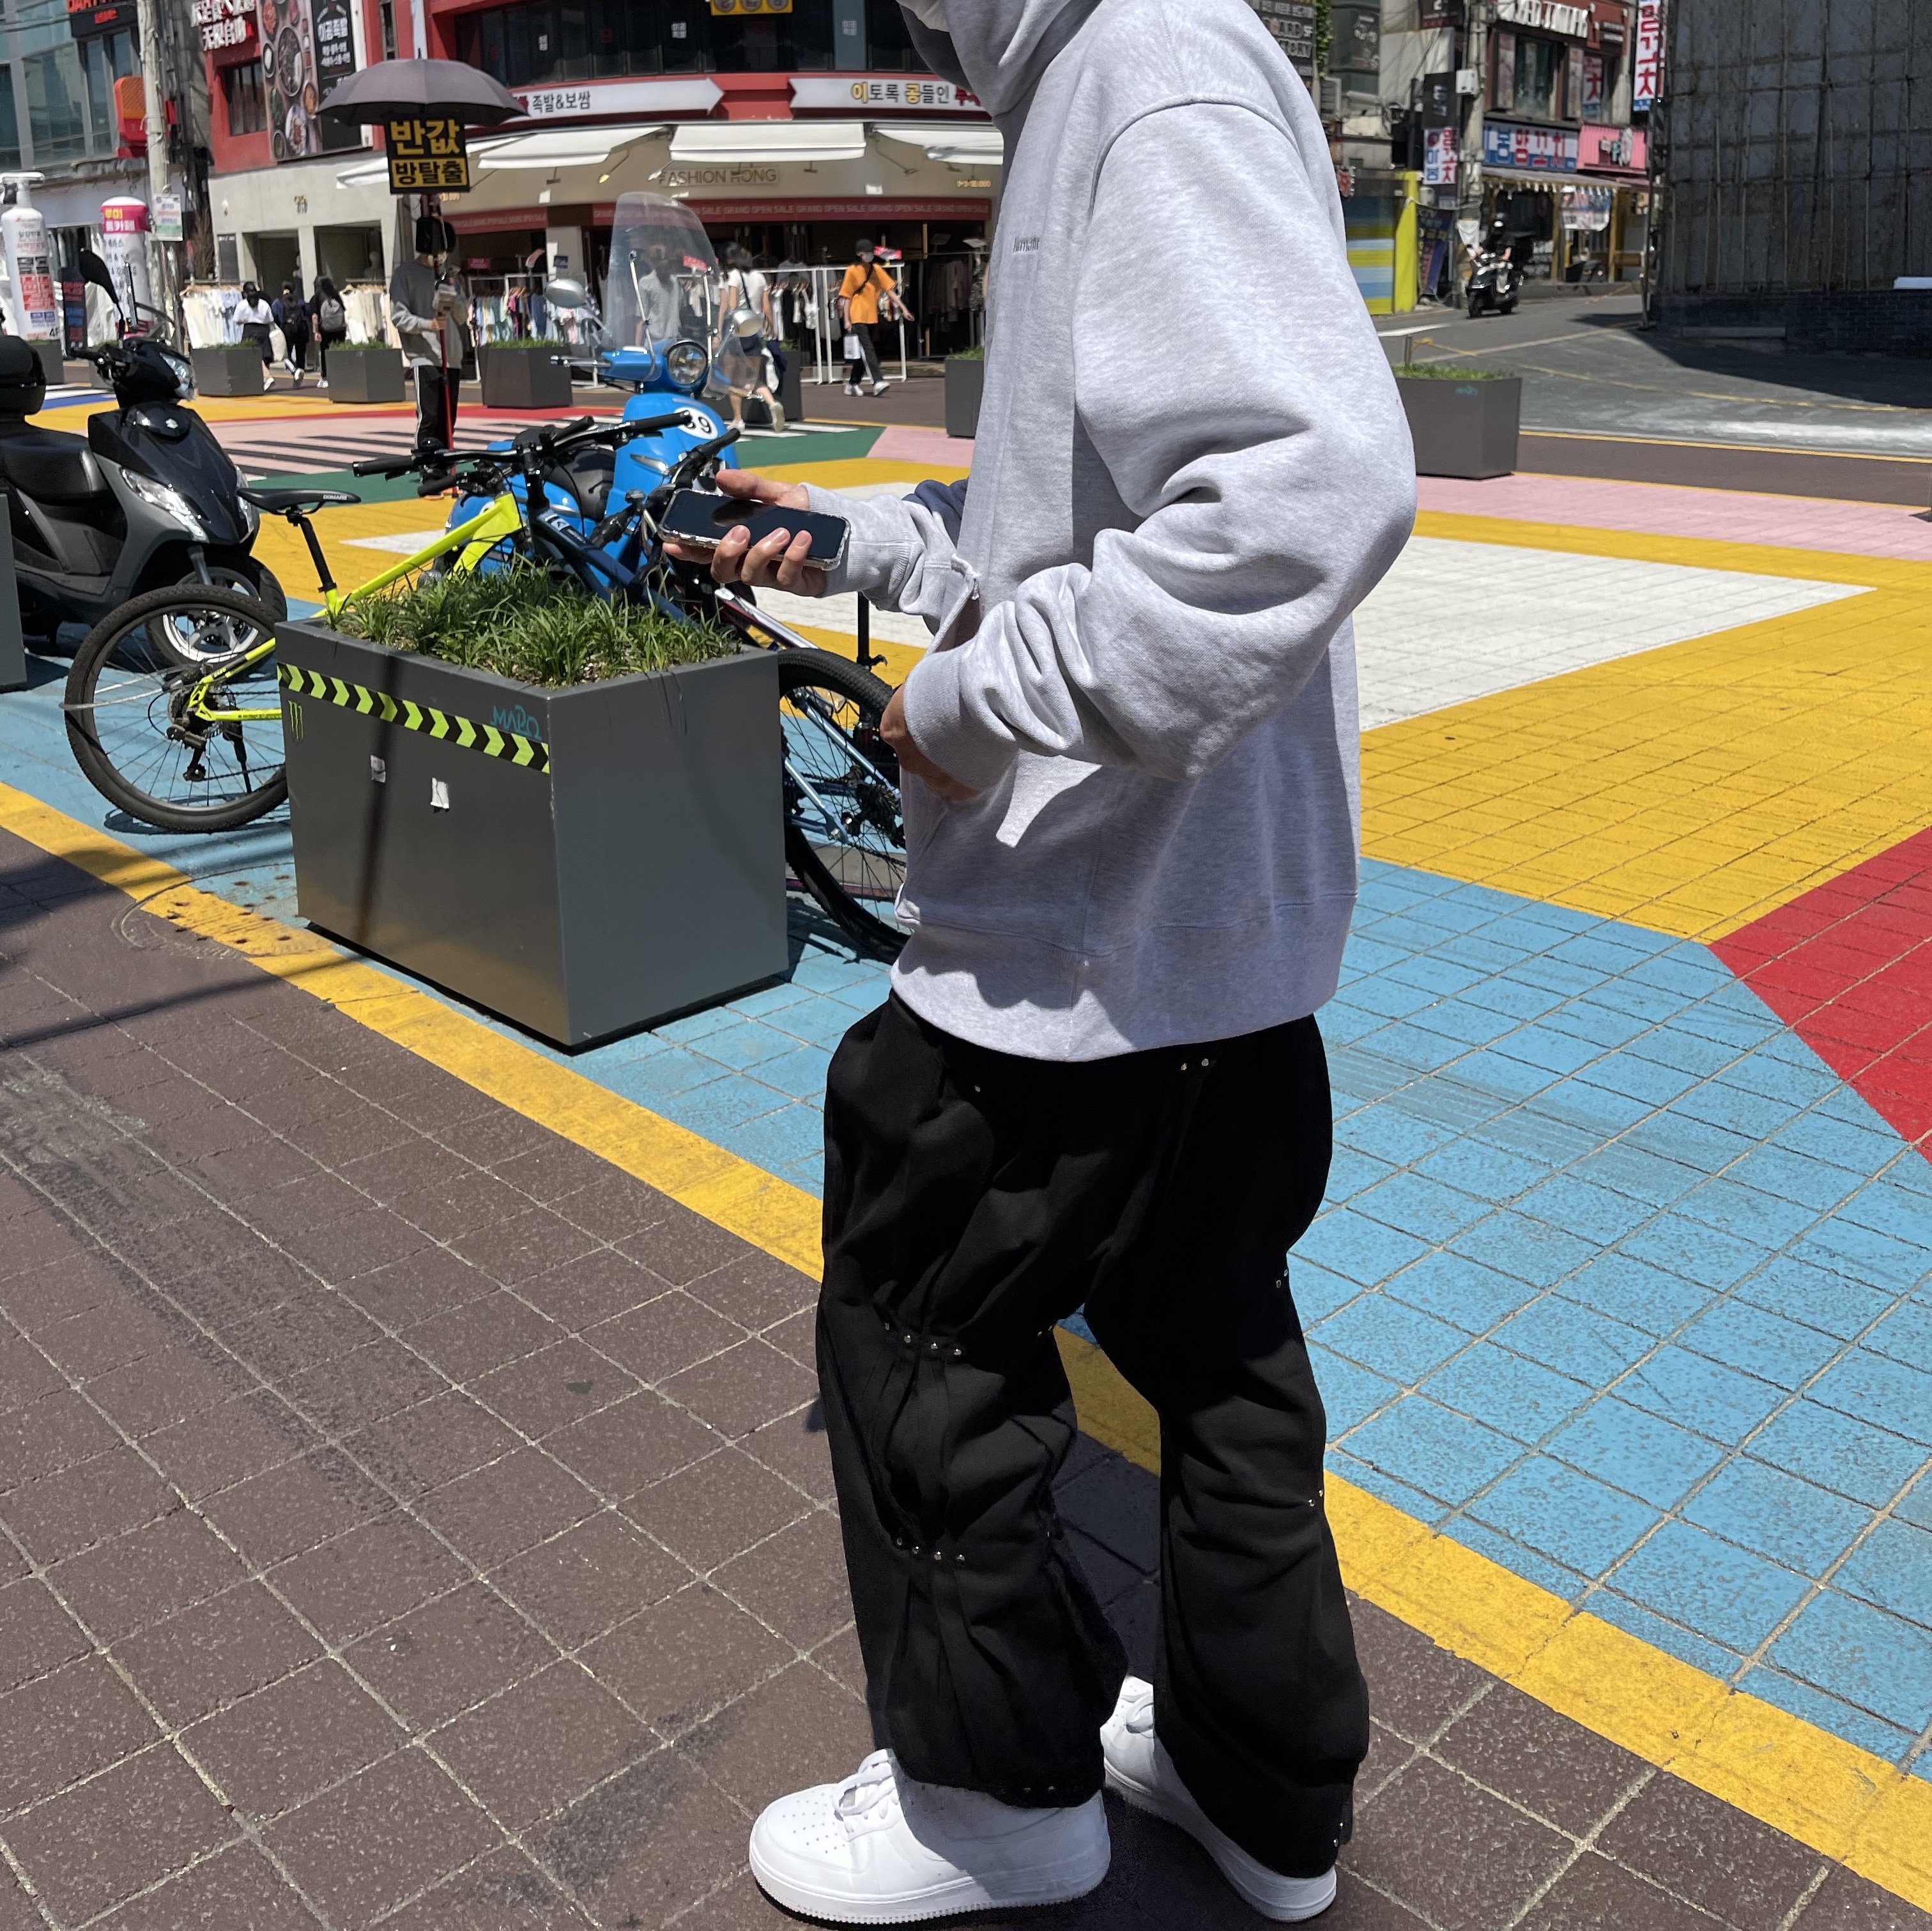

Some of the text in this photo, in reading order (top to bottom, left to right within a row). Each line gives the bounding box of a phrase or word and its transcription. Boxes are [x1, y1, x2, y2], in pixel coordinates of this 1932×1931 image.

[533, 91, 590, 114] 족발&보쌈
[851, 80, 899, 103] 이토록
[905, 82, 949, 104] 공들인
[390, 119, 460, 155] 반값
[395, 160, 463, 185] 방탈출
[659, 168, 777, 185] FASHION HONG
